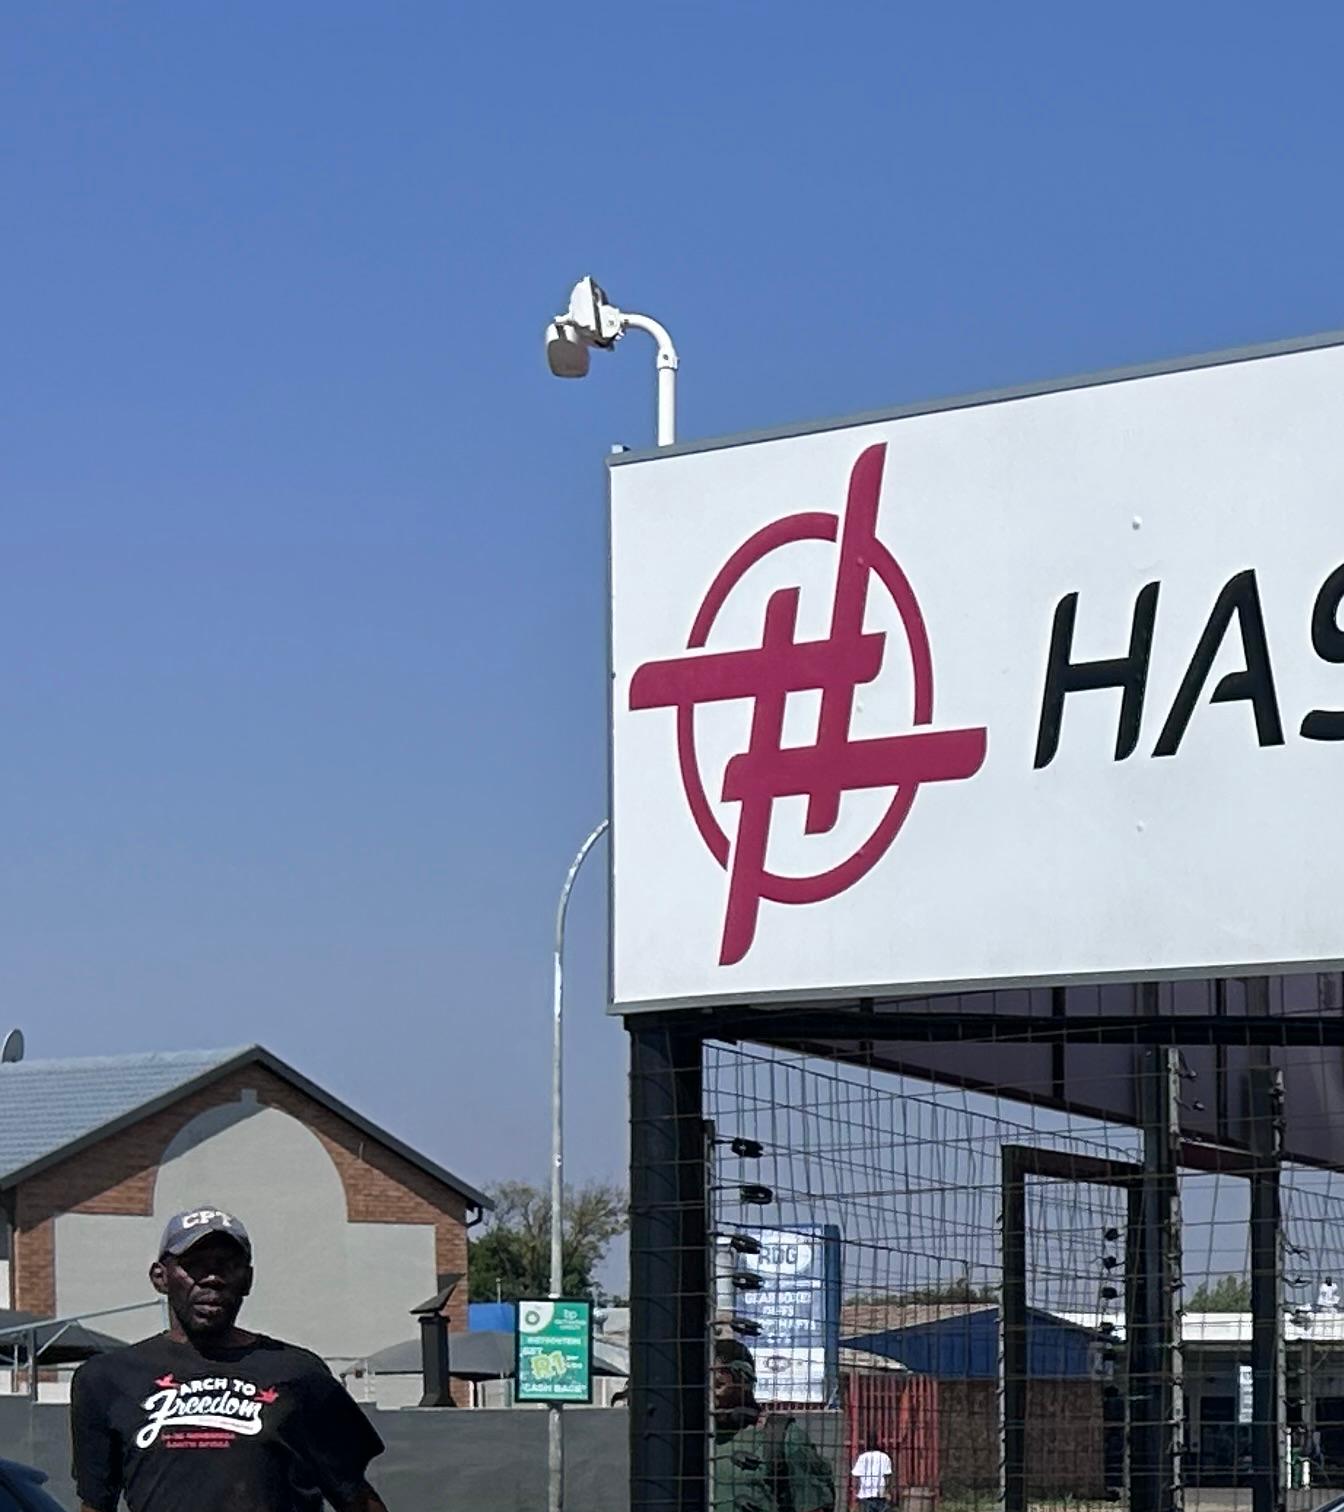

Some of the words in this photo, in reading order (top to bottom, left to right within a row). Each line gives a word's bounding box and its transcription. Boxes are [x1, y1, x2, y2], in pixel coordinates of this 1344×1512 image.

[182, 1210, 233, 1229] CPT
[233, 1378, 257, 1397] TO
[136, 1389, 263, 1449] Freedom
